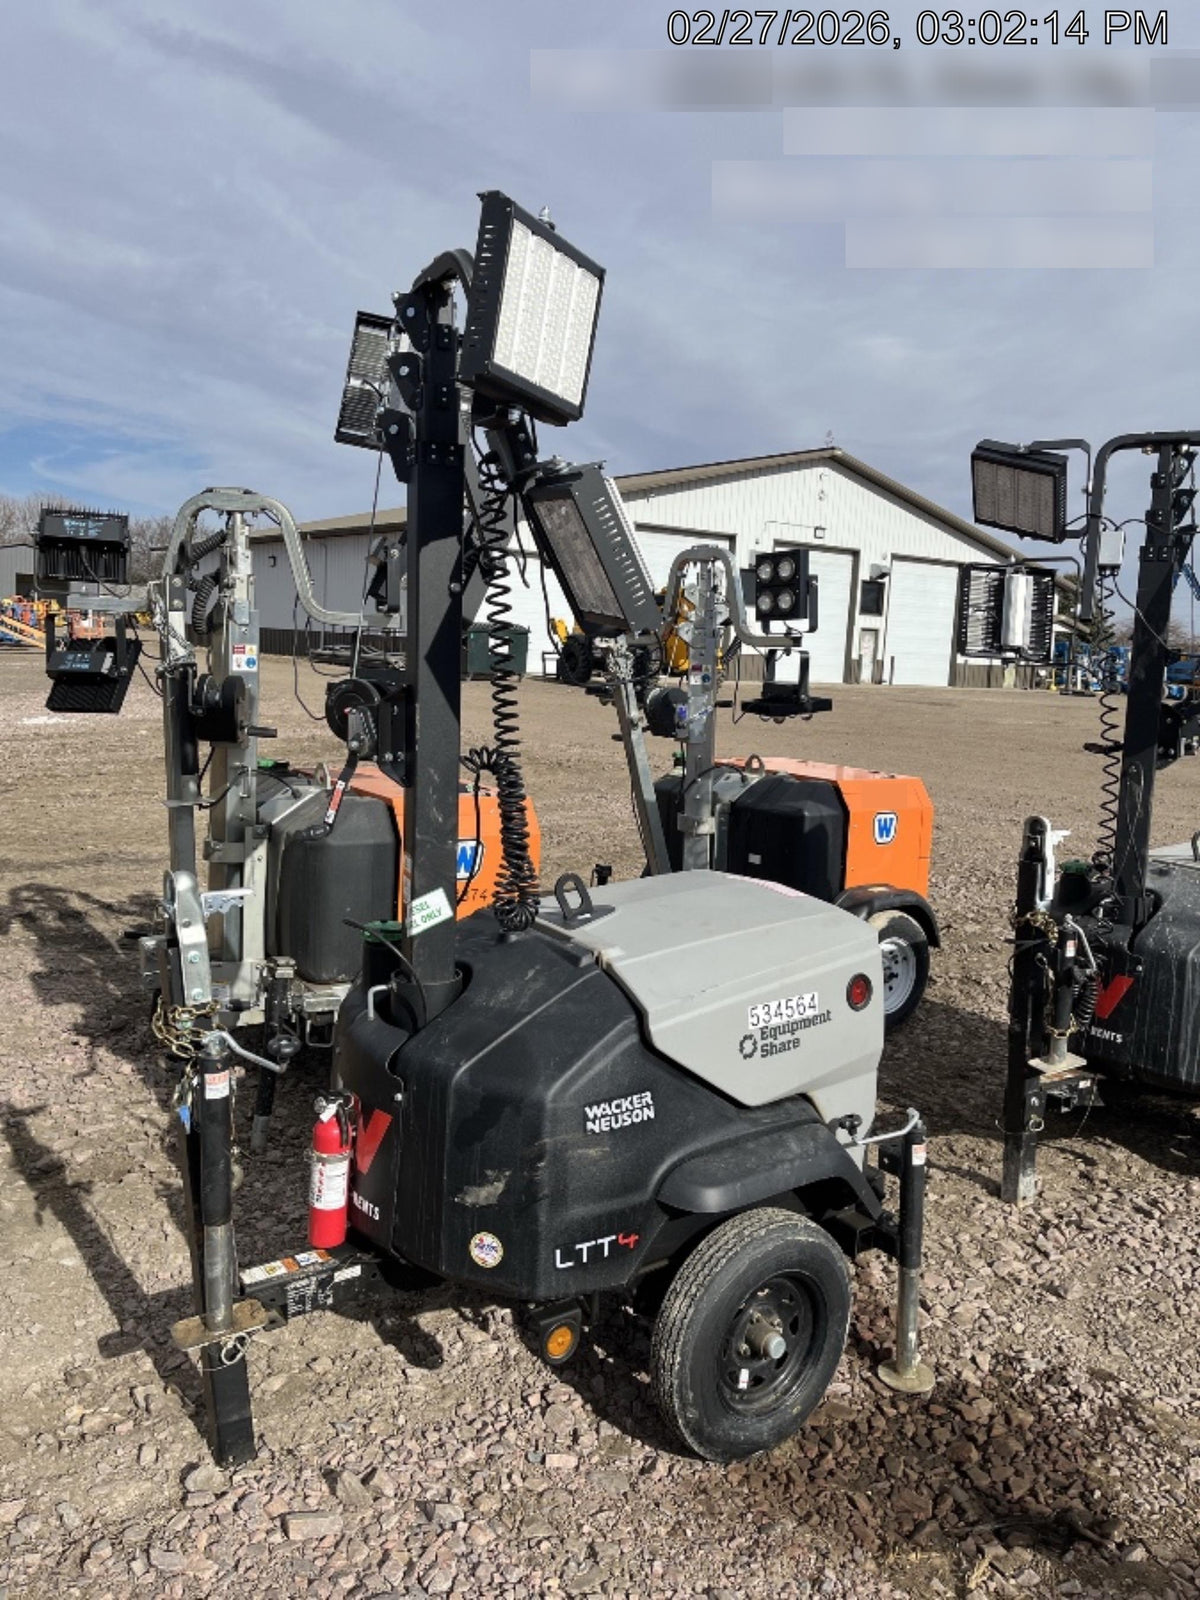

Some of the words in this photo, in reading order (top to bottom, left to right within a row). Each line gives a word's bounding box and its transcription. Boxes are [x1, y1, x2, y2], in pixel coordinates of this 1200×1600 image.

[877, 817, 895, 838] W
[750, 993, 817, 1027] 534564
[760, 1009, 832, 1041] Equipment
[760, 1037, 801, 1058] Share
[585, 1091, 653, 1120] WACKER
[586, 1106, 655, 1135] NEUSON
[555, 1232, 639, 1269] LTT4
